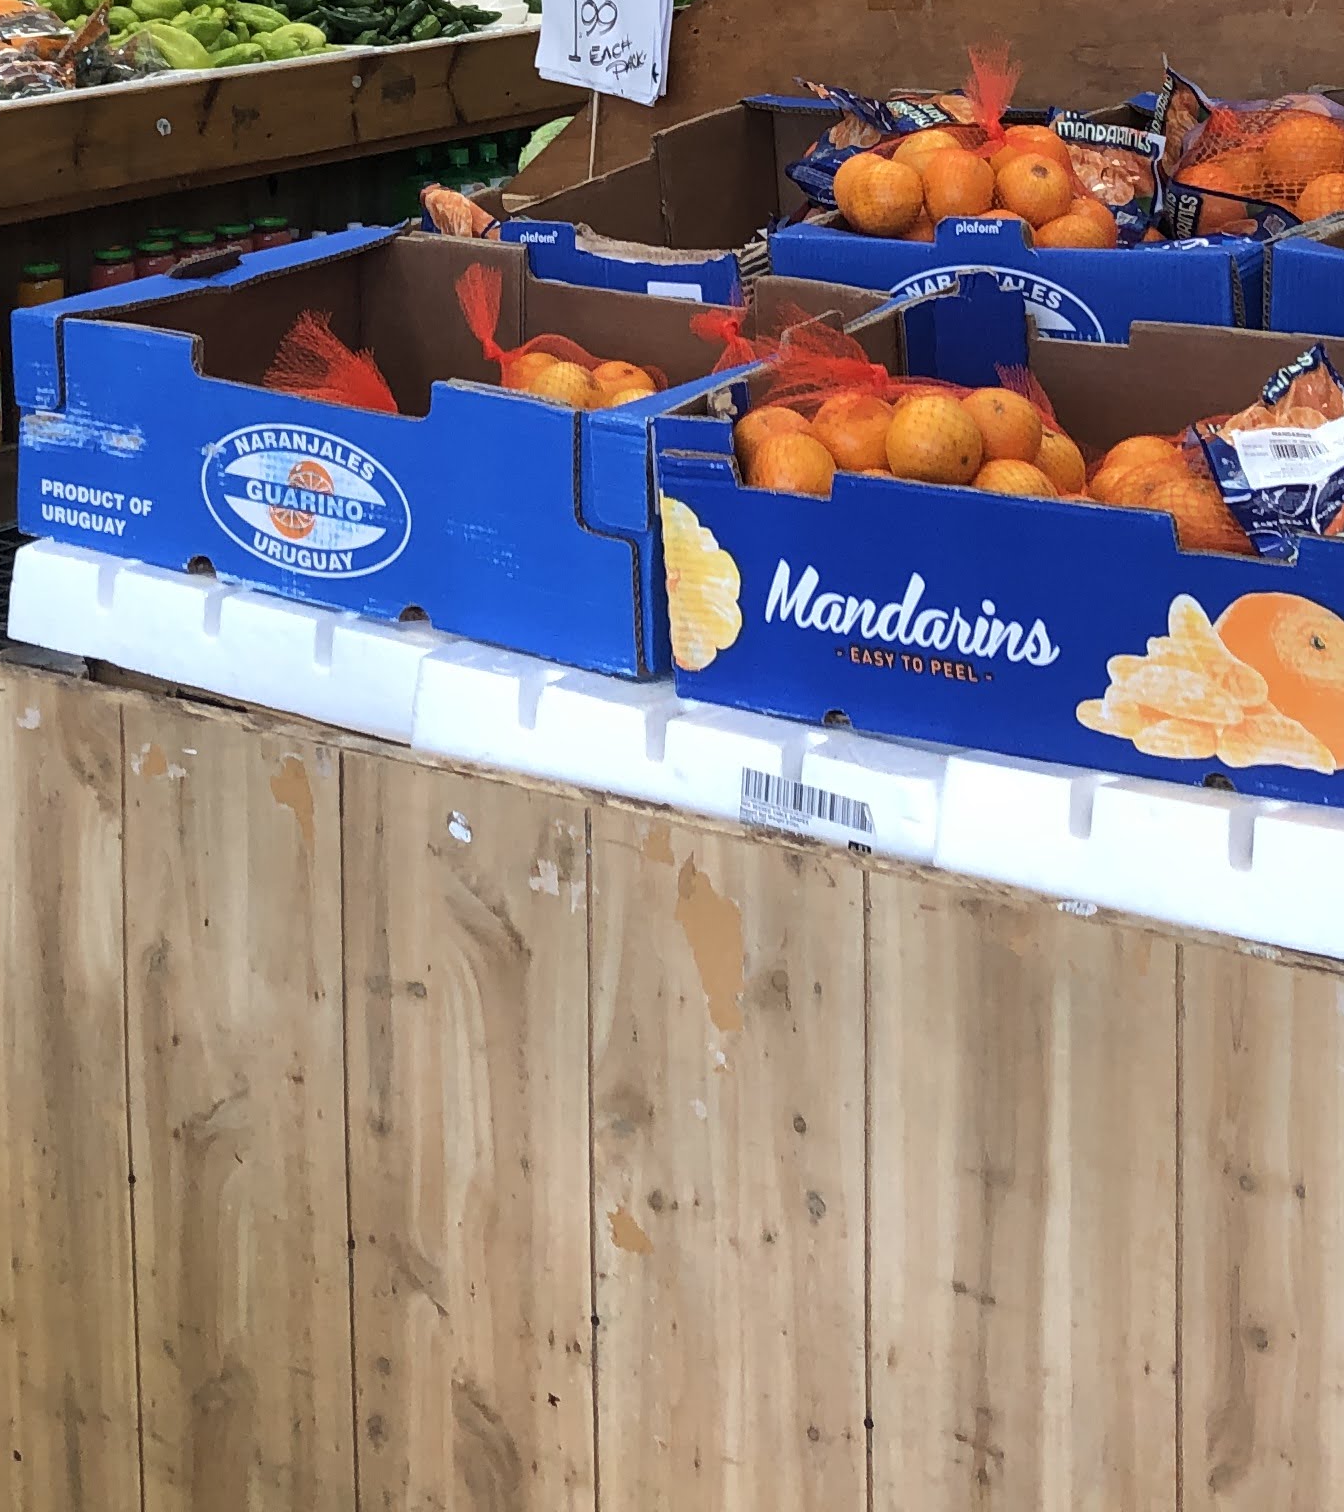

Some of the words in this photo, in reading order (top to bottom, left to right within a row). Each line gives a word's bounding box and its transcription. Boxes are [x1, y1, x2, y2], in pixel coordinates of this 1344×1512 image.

[589, 34, 633, 66] EACH
[1057, 119, 1154, 154] MANDARINES
[234, 430, 376, 482] NARANJALES
[41, 478, 125, 512] PRODUCT
[129, 496, 153, 517] OF
[245, 480, 364, 522] GUARINO
[41, 503, 127, 537] URUGUAY
[253, 531, 354, 572] URUGUAY
[764, 557, 1061, 666] Mandarins
[850, 645, 894, 670] EASY
[900, 654, 923, 673] TO
[930, 657, 979, 682] PEEL
